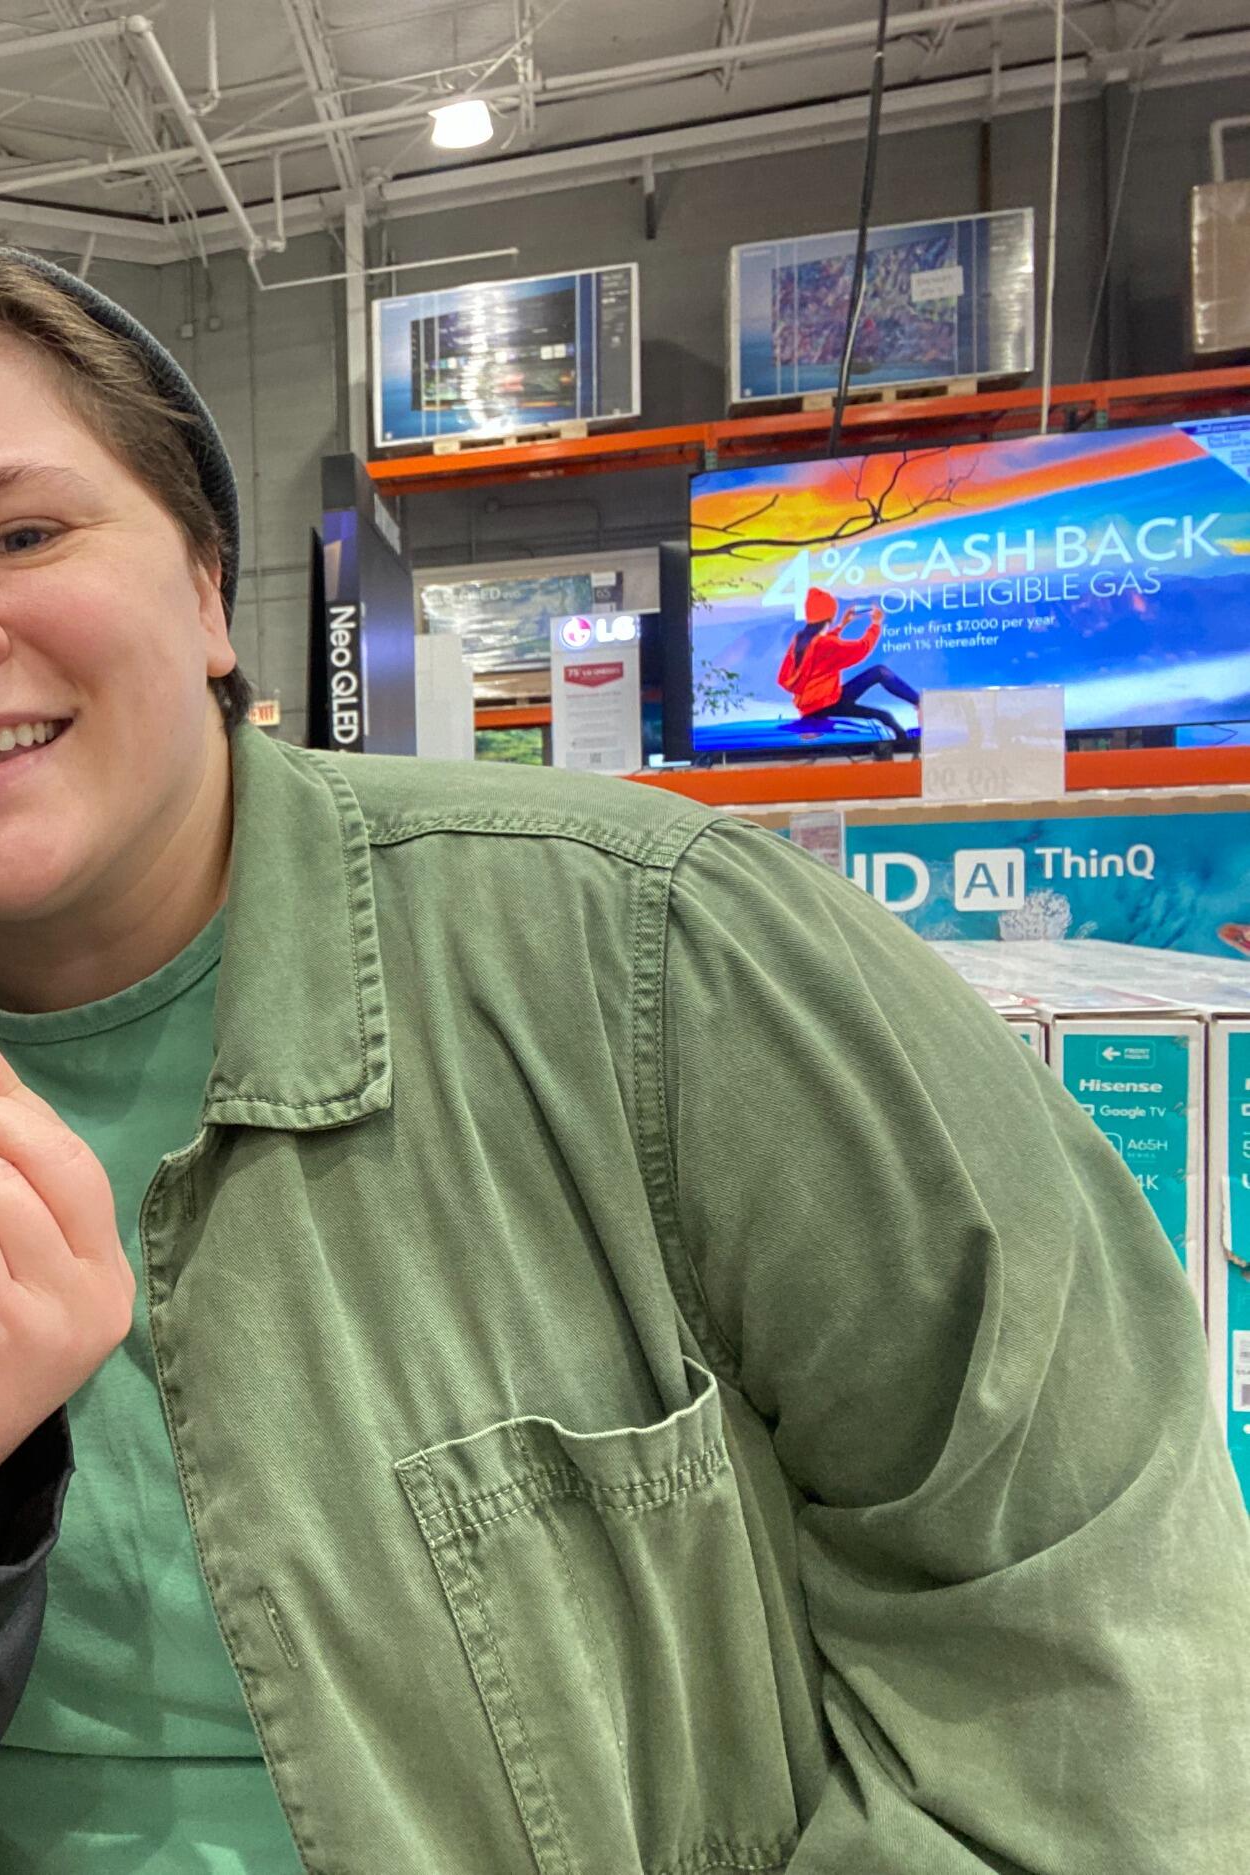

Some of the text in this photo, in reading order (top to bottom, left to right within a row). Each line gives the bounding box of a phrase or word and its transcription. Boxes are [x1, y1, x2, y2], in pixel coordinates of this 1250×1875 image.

[880, 529, 1035, 582] CASH
[1056, 513, 1222, 569] BACK
[880, 567, 1162, 614] ON ELIGIBLE GAS
[595, 616, 636, 643] LG
[883, 624, 901, 637] for
[904, 622, 925, 636] the
[928, 620, 953, 634] first
[1002, 618, 1024, 631] per
[1027, 615, 1056, 630] year
[882, 632, 999, 653] then 1% thereafter
[329, 605, 359, 745] Neo QLED
[962, 861, 1016, 899] AI
[1034, 844, 1156, 880] ThinQ
[1079, 1078, 1163, 1094] Hisense
[1100, 1104, 1167, 1119] Google TV
[1127, 1138, 1168, 1151] A65H
